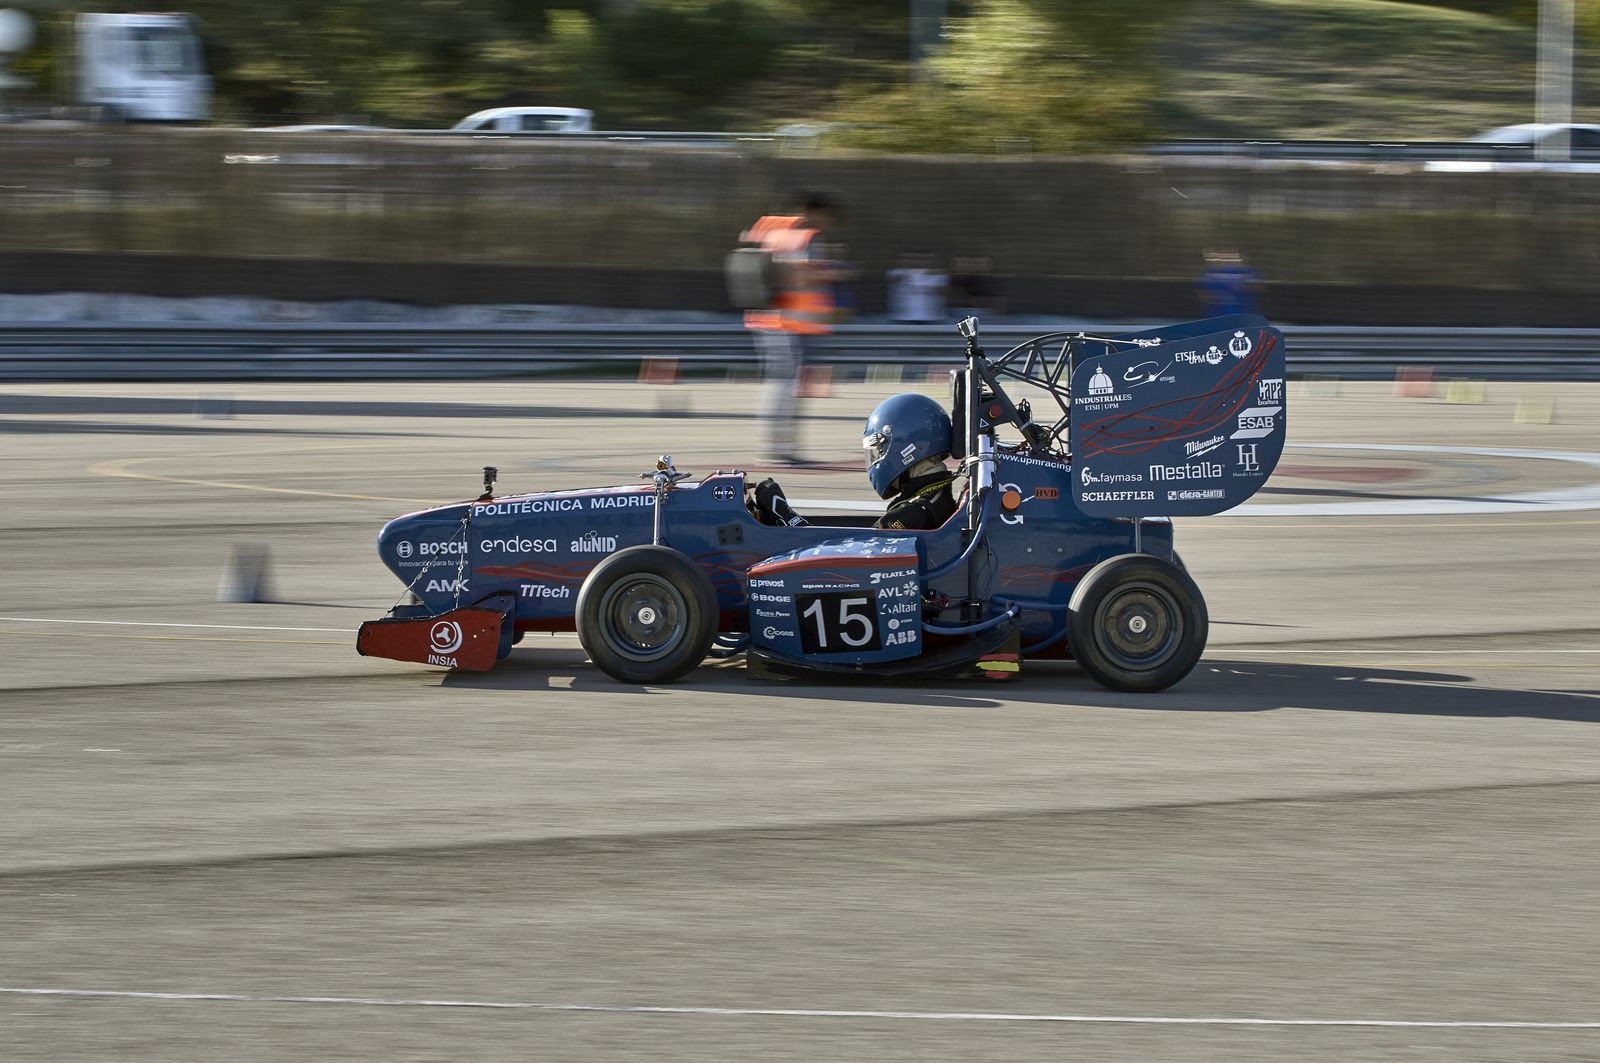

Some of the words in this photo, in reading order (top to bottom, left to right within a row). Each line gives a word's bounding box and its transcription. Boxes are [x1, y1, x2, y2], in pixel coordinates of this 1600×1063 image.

[1075, 393, 1133, 405] INDUSTRIALES
[1104, 402, 1119, 410] UPM
[1238, 416, 1275, 429] ESAB
[1149, 461, 1222, 481] Mestalla
[1100, 472, 1143, 485] faymasa
[1081, 491, 1155, 502] SCHAEFFLER
[474, 500, 583, 517] POLITÉCNICA
[590, 494, 656, 510] MADRID
[419, 541, 468, 555] BOSCH
[480, 535, 557, 553] endesa
[425, 579, 470, 592] AMK
[757, 579, 785, 588] prevost
[520, 584, 570, 599] TTTech
[878, 586, 903, 599] AVL
[759, 594, 791, 603] BOGE
[892, 601, 917, 614] Altair
[803, 597, 874, 648] 15
[886, 630, 917, 646] ABB
[427, 654, 458, 668] INSIA
